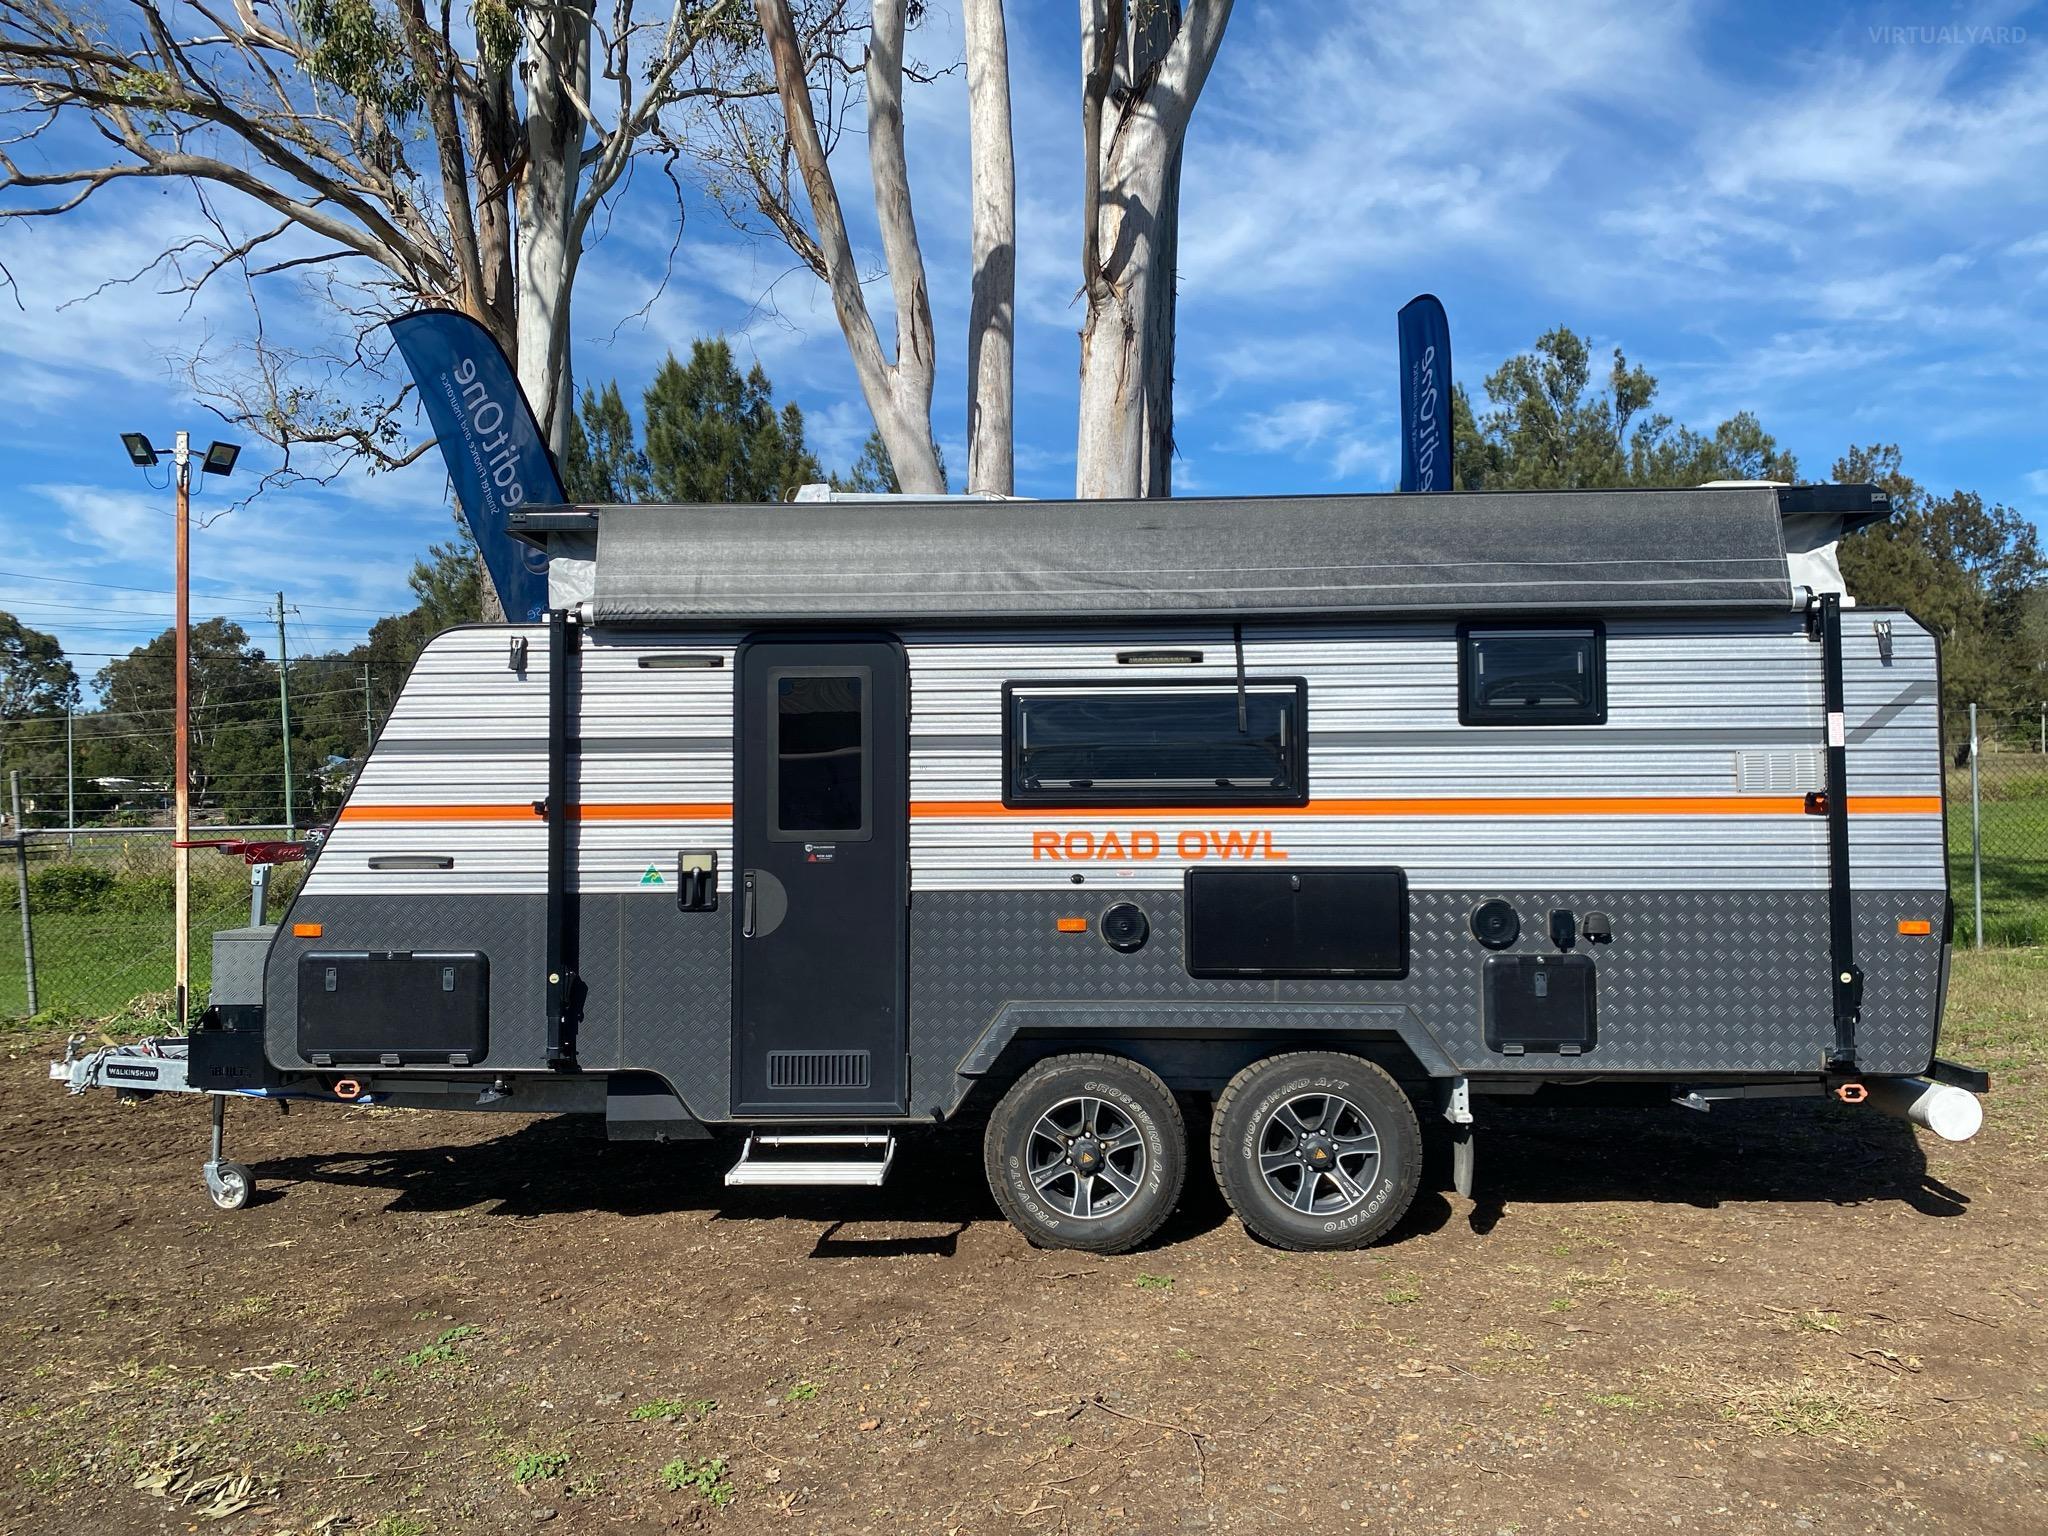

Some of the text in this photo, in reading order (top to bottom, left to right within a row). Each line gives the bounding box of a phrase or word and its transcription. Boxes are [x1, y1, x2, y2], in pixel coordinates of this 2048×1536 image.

[1032, 830, 1288, 861] ROAD OWL
[108, 1067, 156, 1078] WALKINSHAW
[1084, 1081, 1163, 1194] CROSSWIND A/T
[1242, 1077, 1350, 1159] CROSSWIND A/T
[1009, 1155, 1060, 1229] PROVATO
[1324, 1179, 1394, 1232] PROVATO
